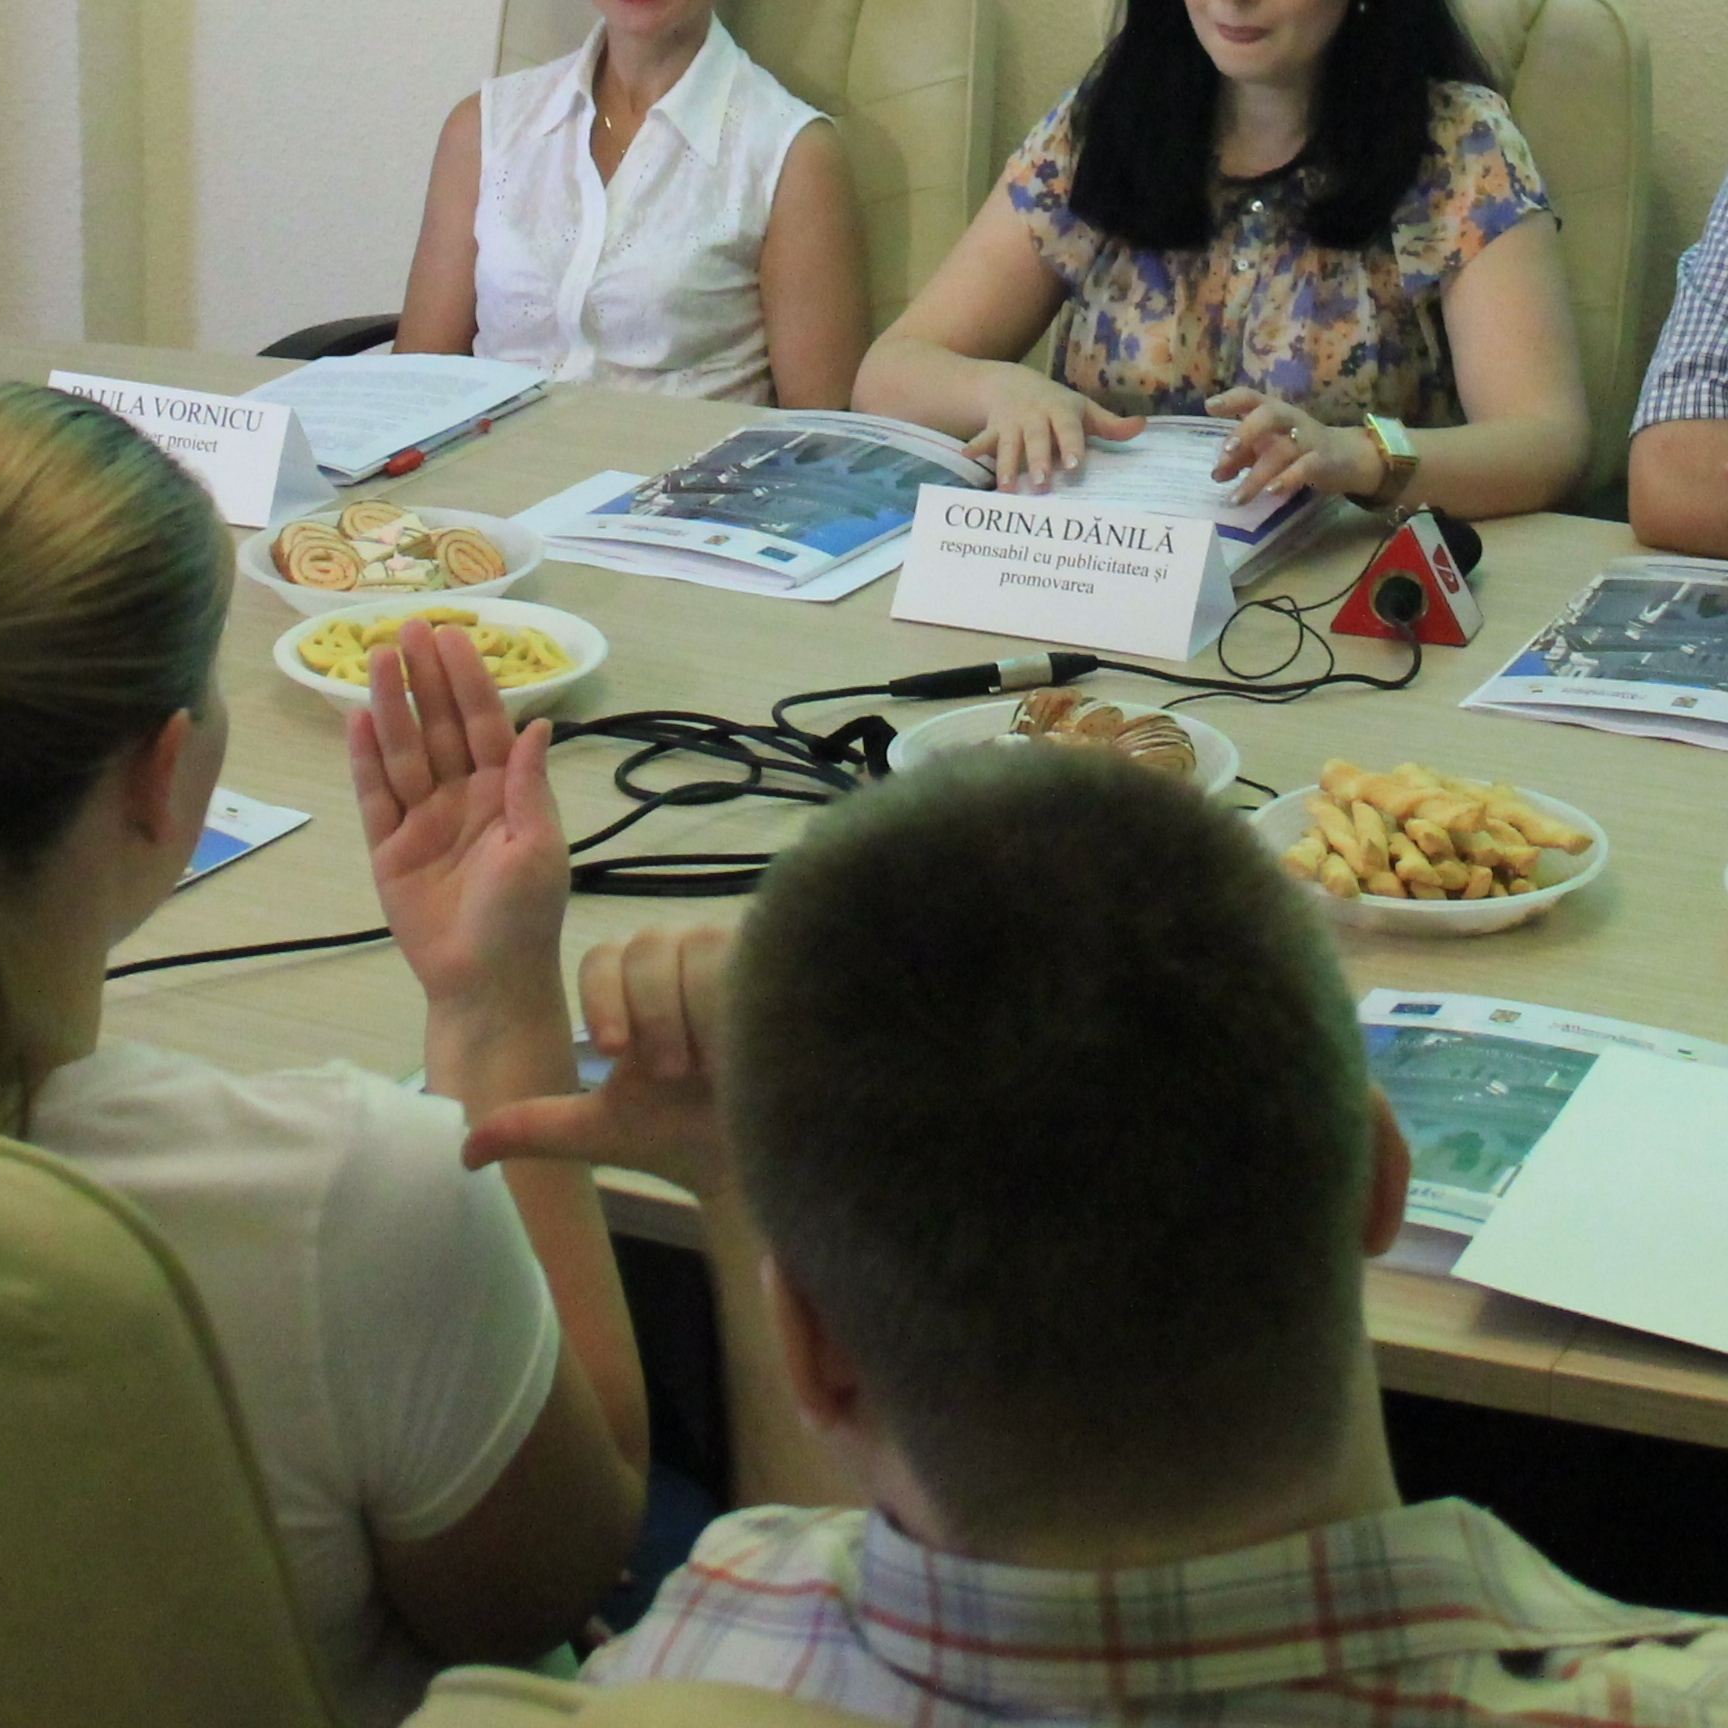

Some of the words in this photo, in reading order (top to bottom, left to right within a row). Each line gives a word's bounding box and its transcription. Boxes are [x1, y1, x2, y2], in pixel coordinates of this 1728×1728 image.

[154, 396, 264, 432] VORNICU
[167, 435, 218, 454] proiect
[945, 504, 1055, 539] CORINA
[1062, 516, 1175, 554] DĂNILĂ
[939, 538, 1028, 562] responsabil
[1033, 552, 1051, 564] cu
[1056, 553, 1149, 577] publicitatea
[999, 570, 1094, 595] promovarea
